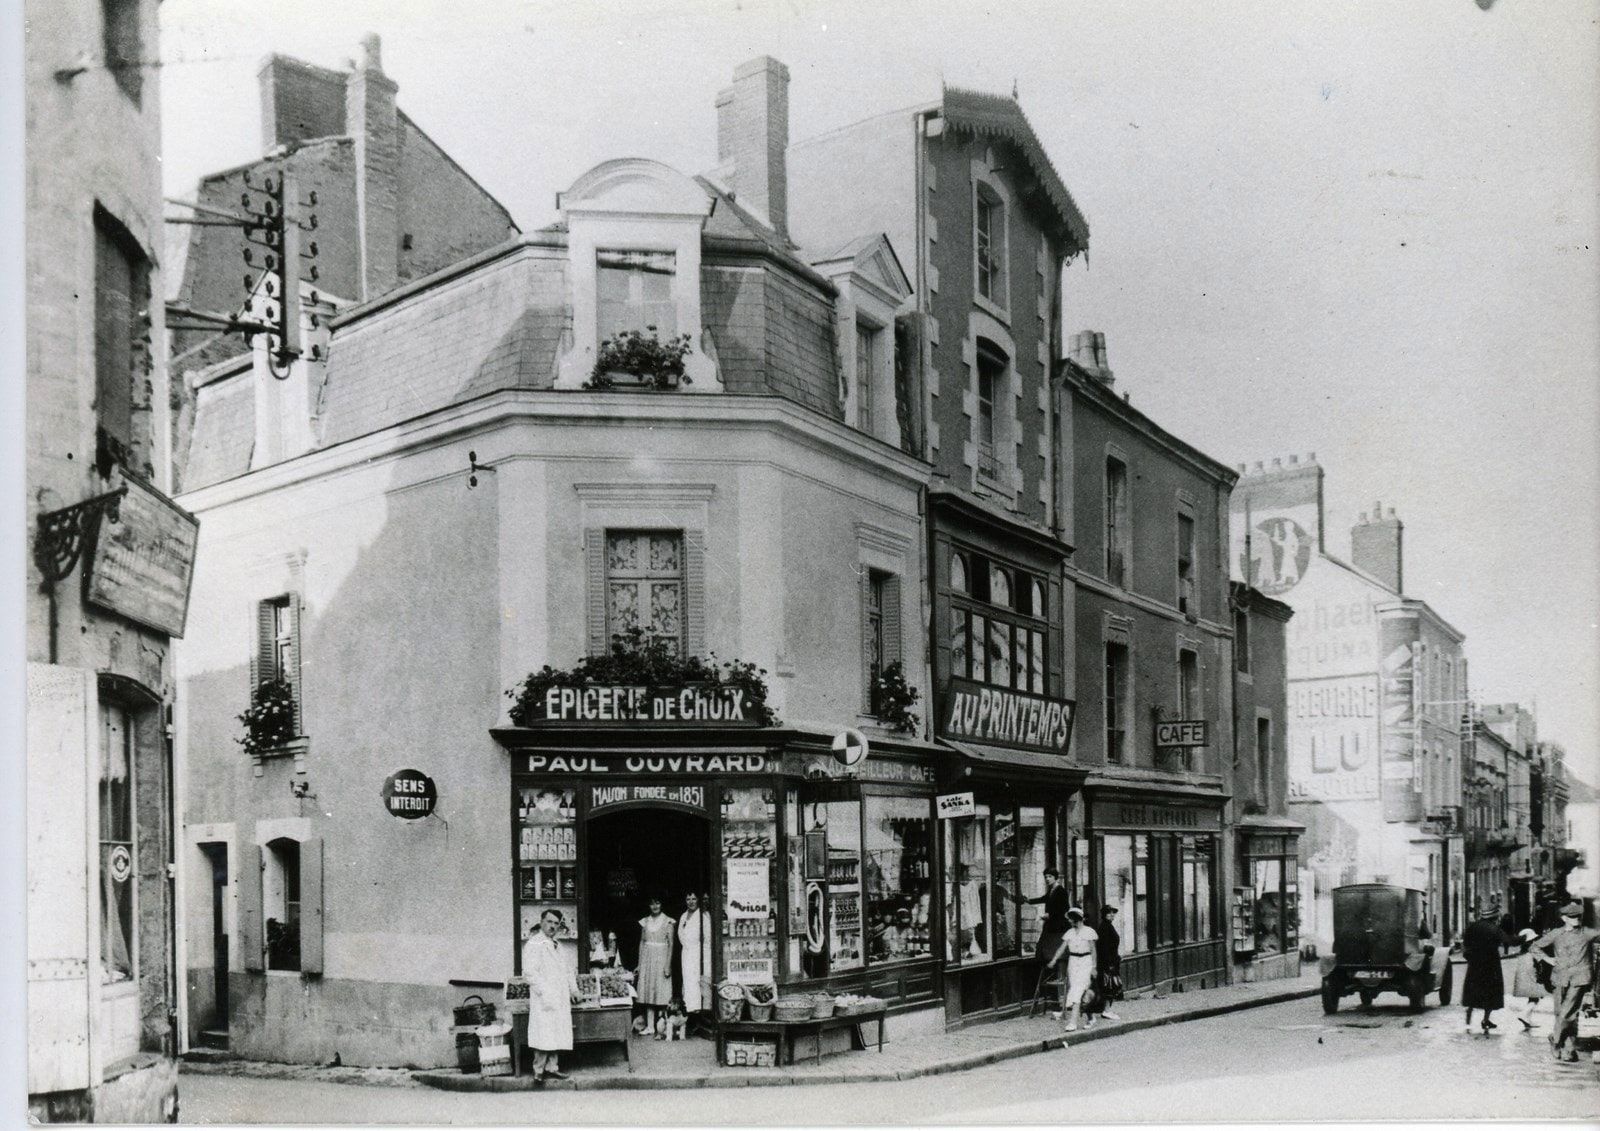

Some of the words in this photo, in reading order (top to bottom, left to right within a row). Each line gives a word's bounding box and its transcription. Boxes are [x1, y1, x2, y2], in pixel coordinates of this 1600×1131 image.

[948, 691, 979, 736] AU
[975, 688, 1070, 749] PRINTEMPS
[1159, 721, 1203, 743] CAFÉ
[1311, 729, 1369, 774] LU
[529, 755, 609, 772] PAUL
[626, 755, 765, 772] OUVRARD
[394, 779, 425, 793] SENS
[592, 786, 627, 807] MAISON
[679, 786, 704, 808] 1851
[390, 796, 430, 811] INTERDIT
